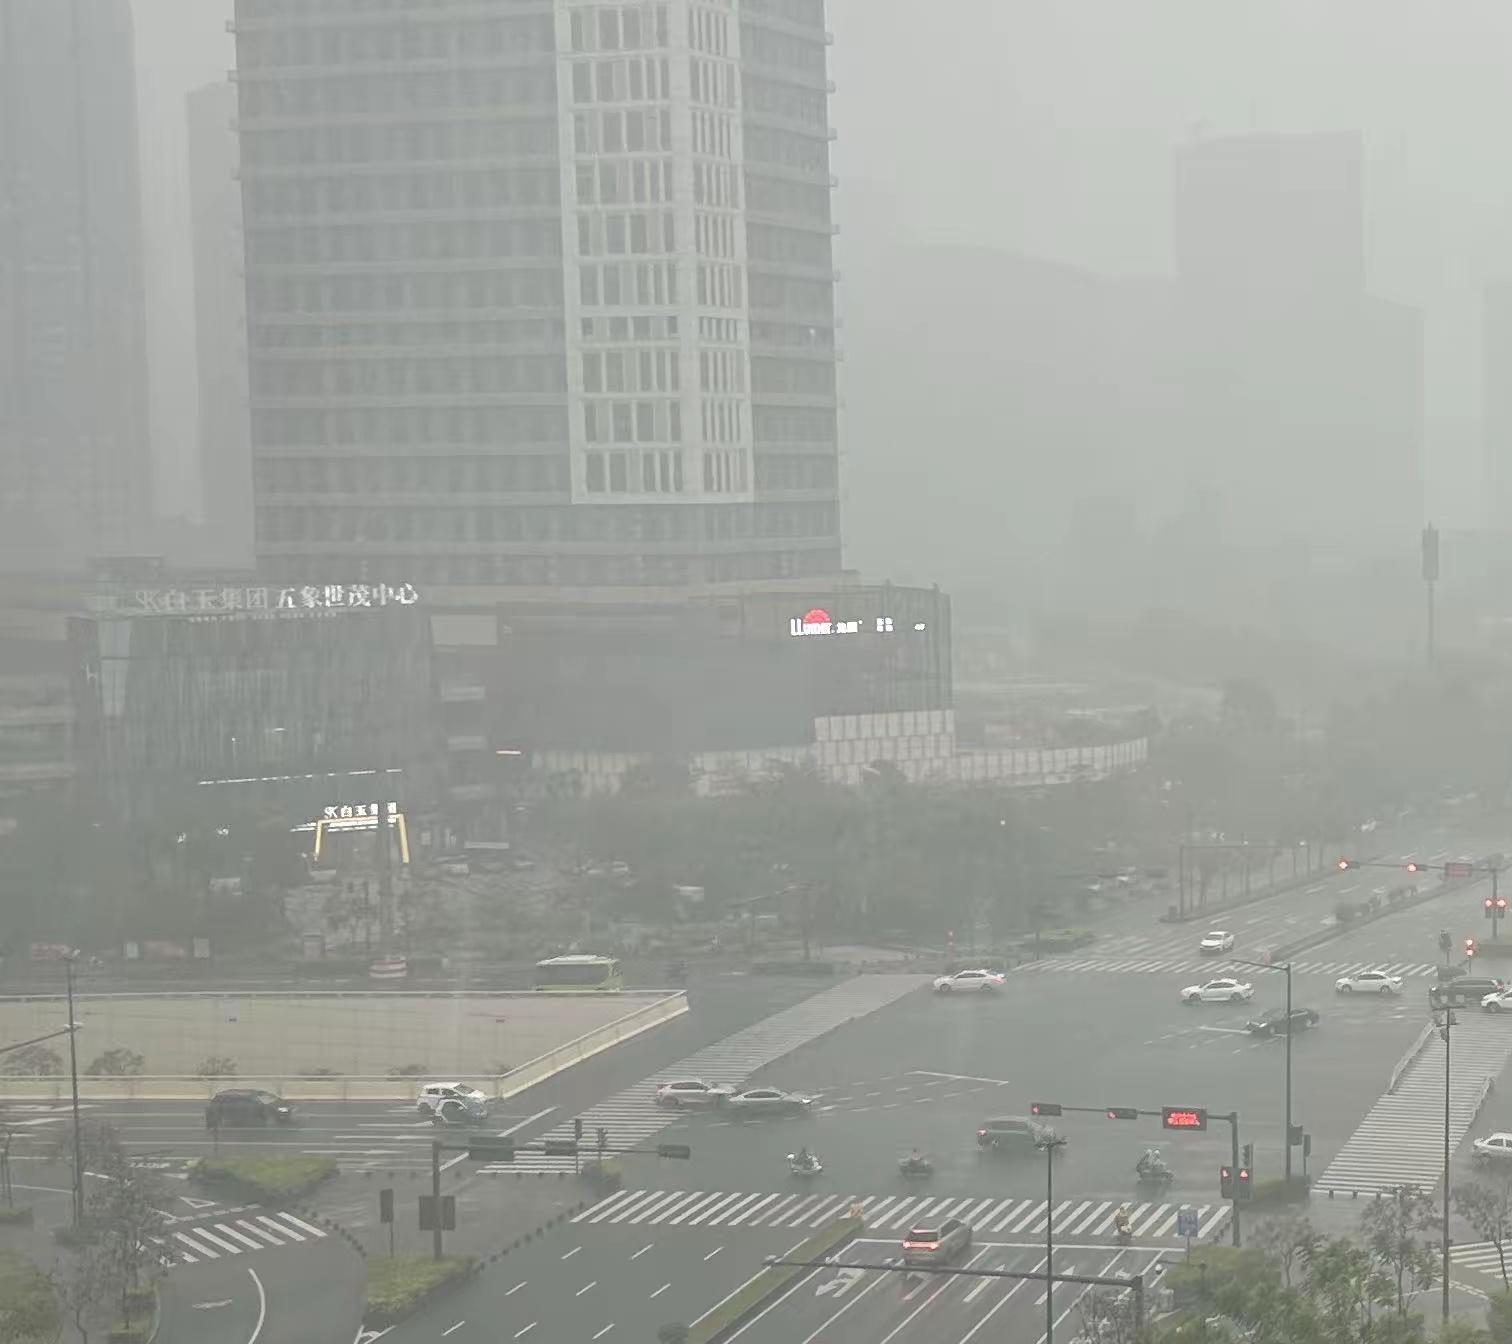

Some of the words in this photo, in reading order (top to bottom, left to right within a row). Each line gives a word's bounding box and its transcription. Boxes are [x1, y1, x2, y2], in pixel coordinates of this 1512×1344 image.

[276, 582, 418, 608] 五象世茂中心
